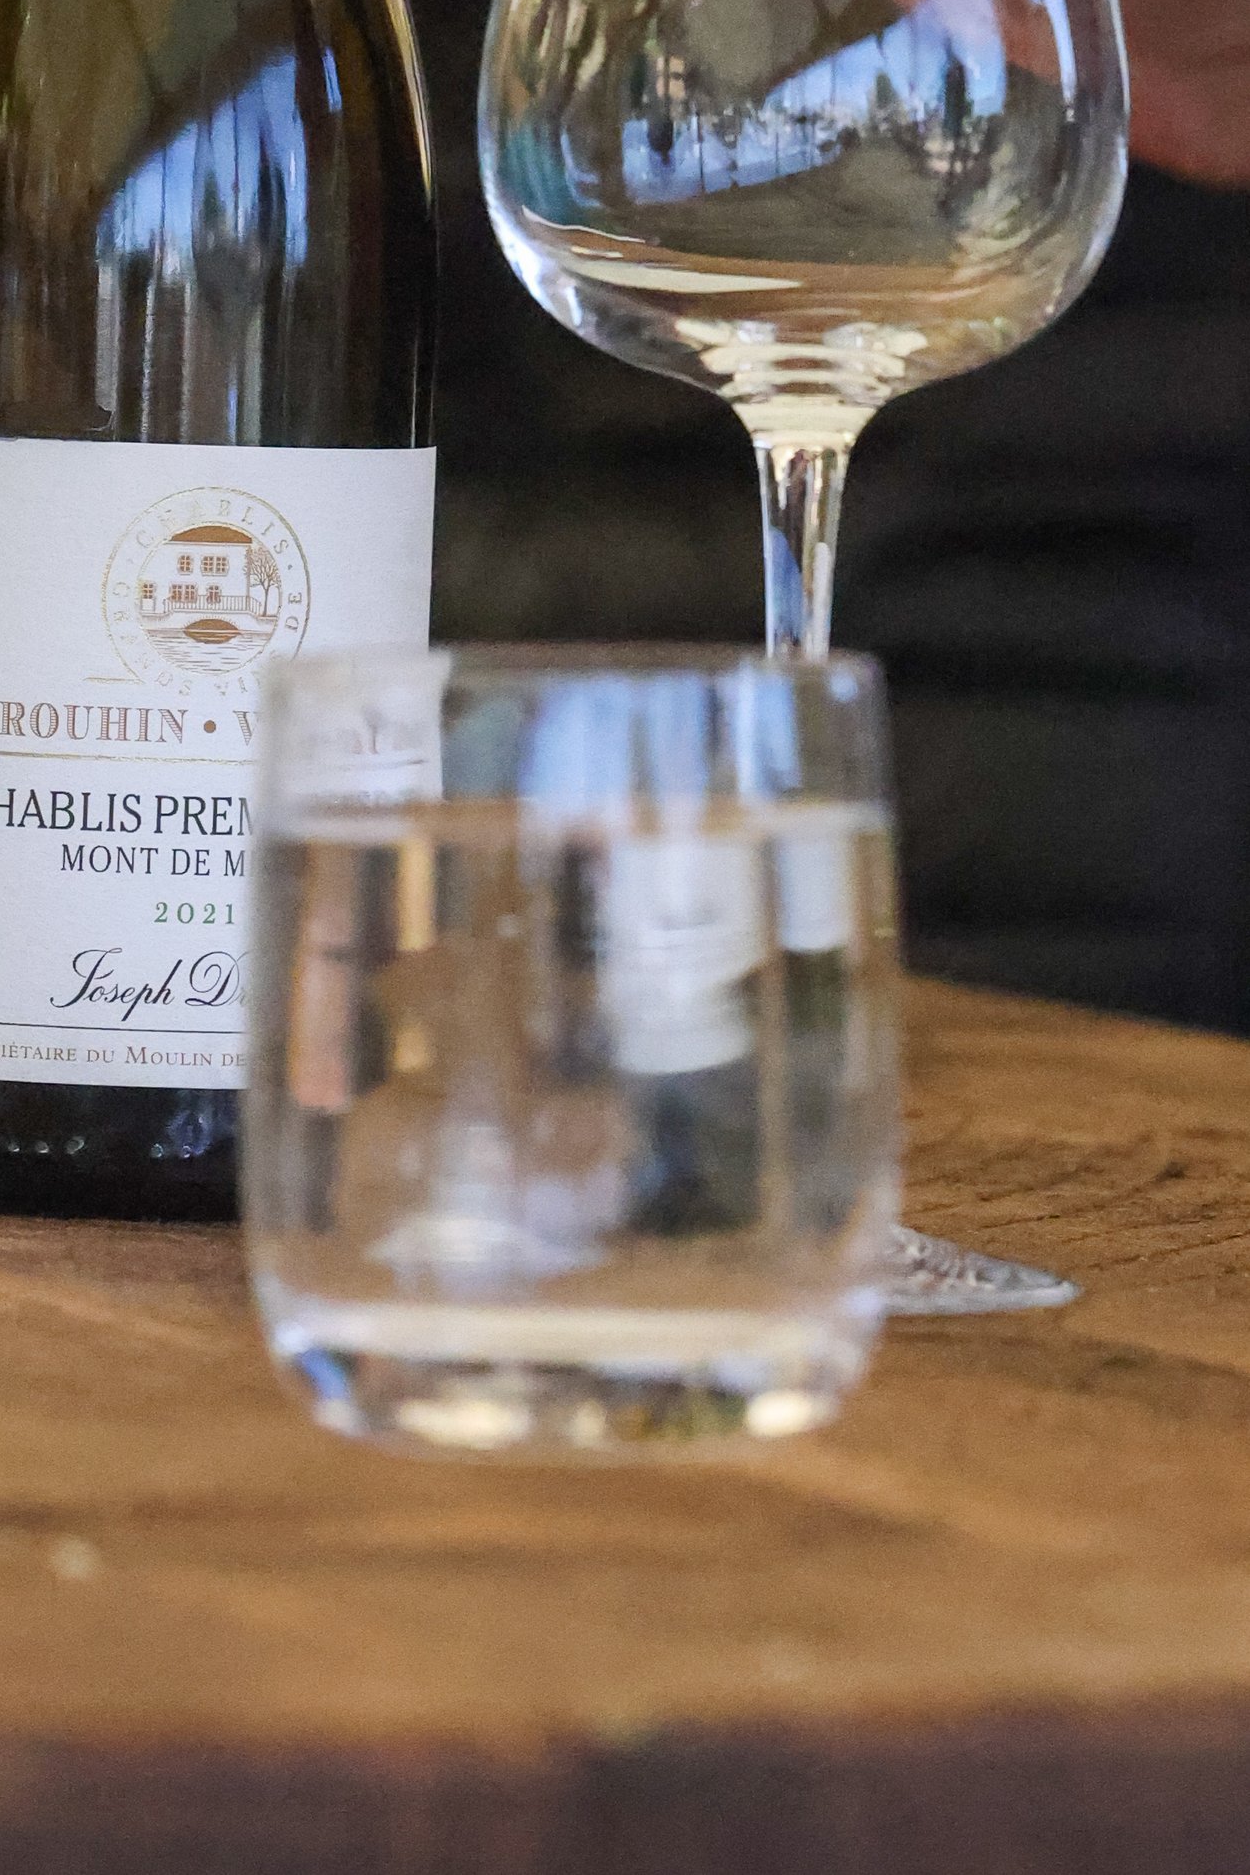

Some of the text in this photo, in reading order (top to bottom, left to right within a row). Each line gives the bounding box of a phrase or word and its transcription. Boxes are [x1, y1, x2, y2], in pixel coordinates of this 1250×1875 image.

[136, 499, 290, 555] CBLIS
[60, 843, 159, 875] MONT
[170, 848, 211, 876] DE
[153, 901, 235, 926] 2021
[49, 947, 184, 1022] Joseph
